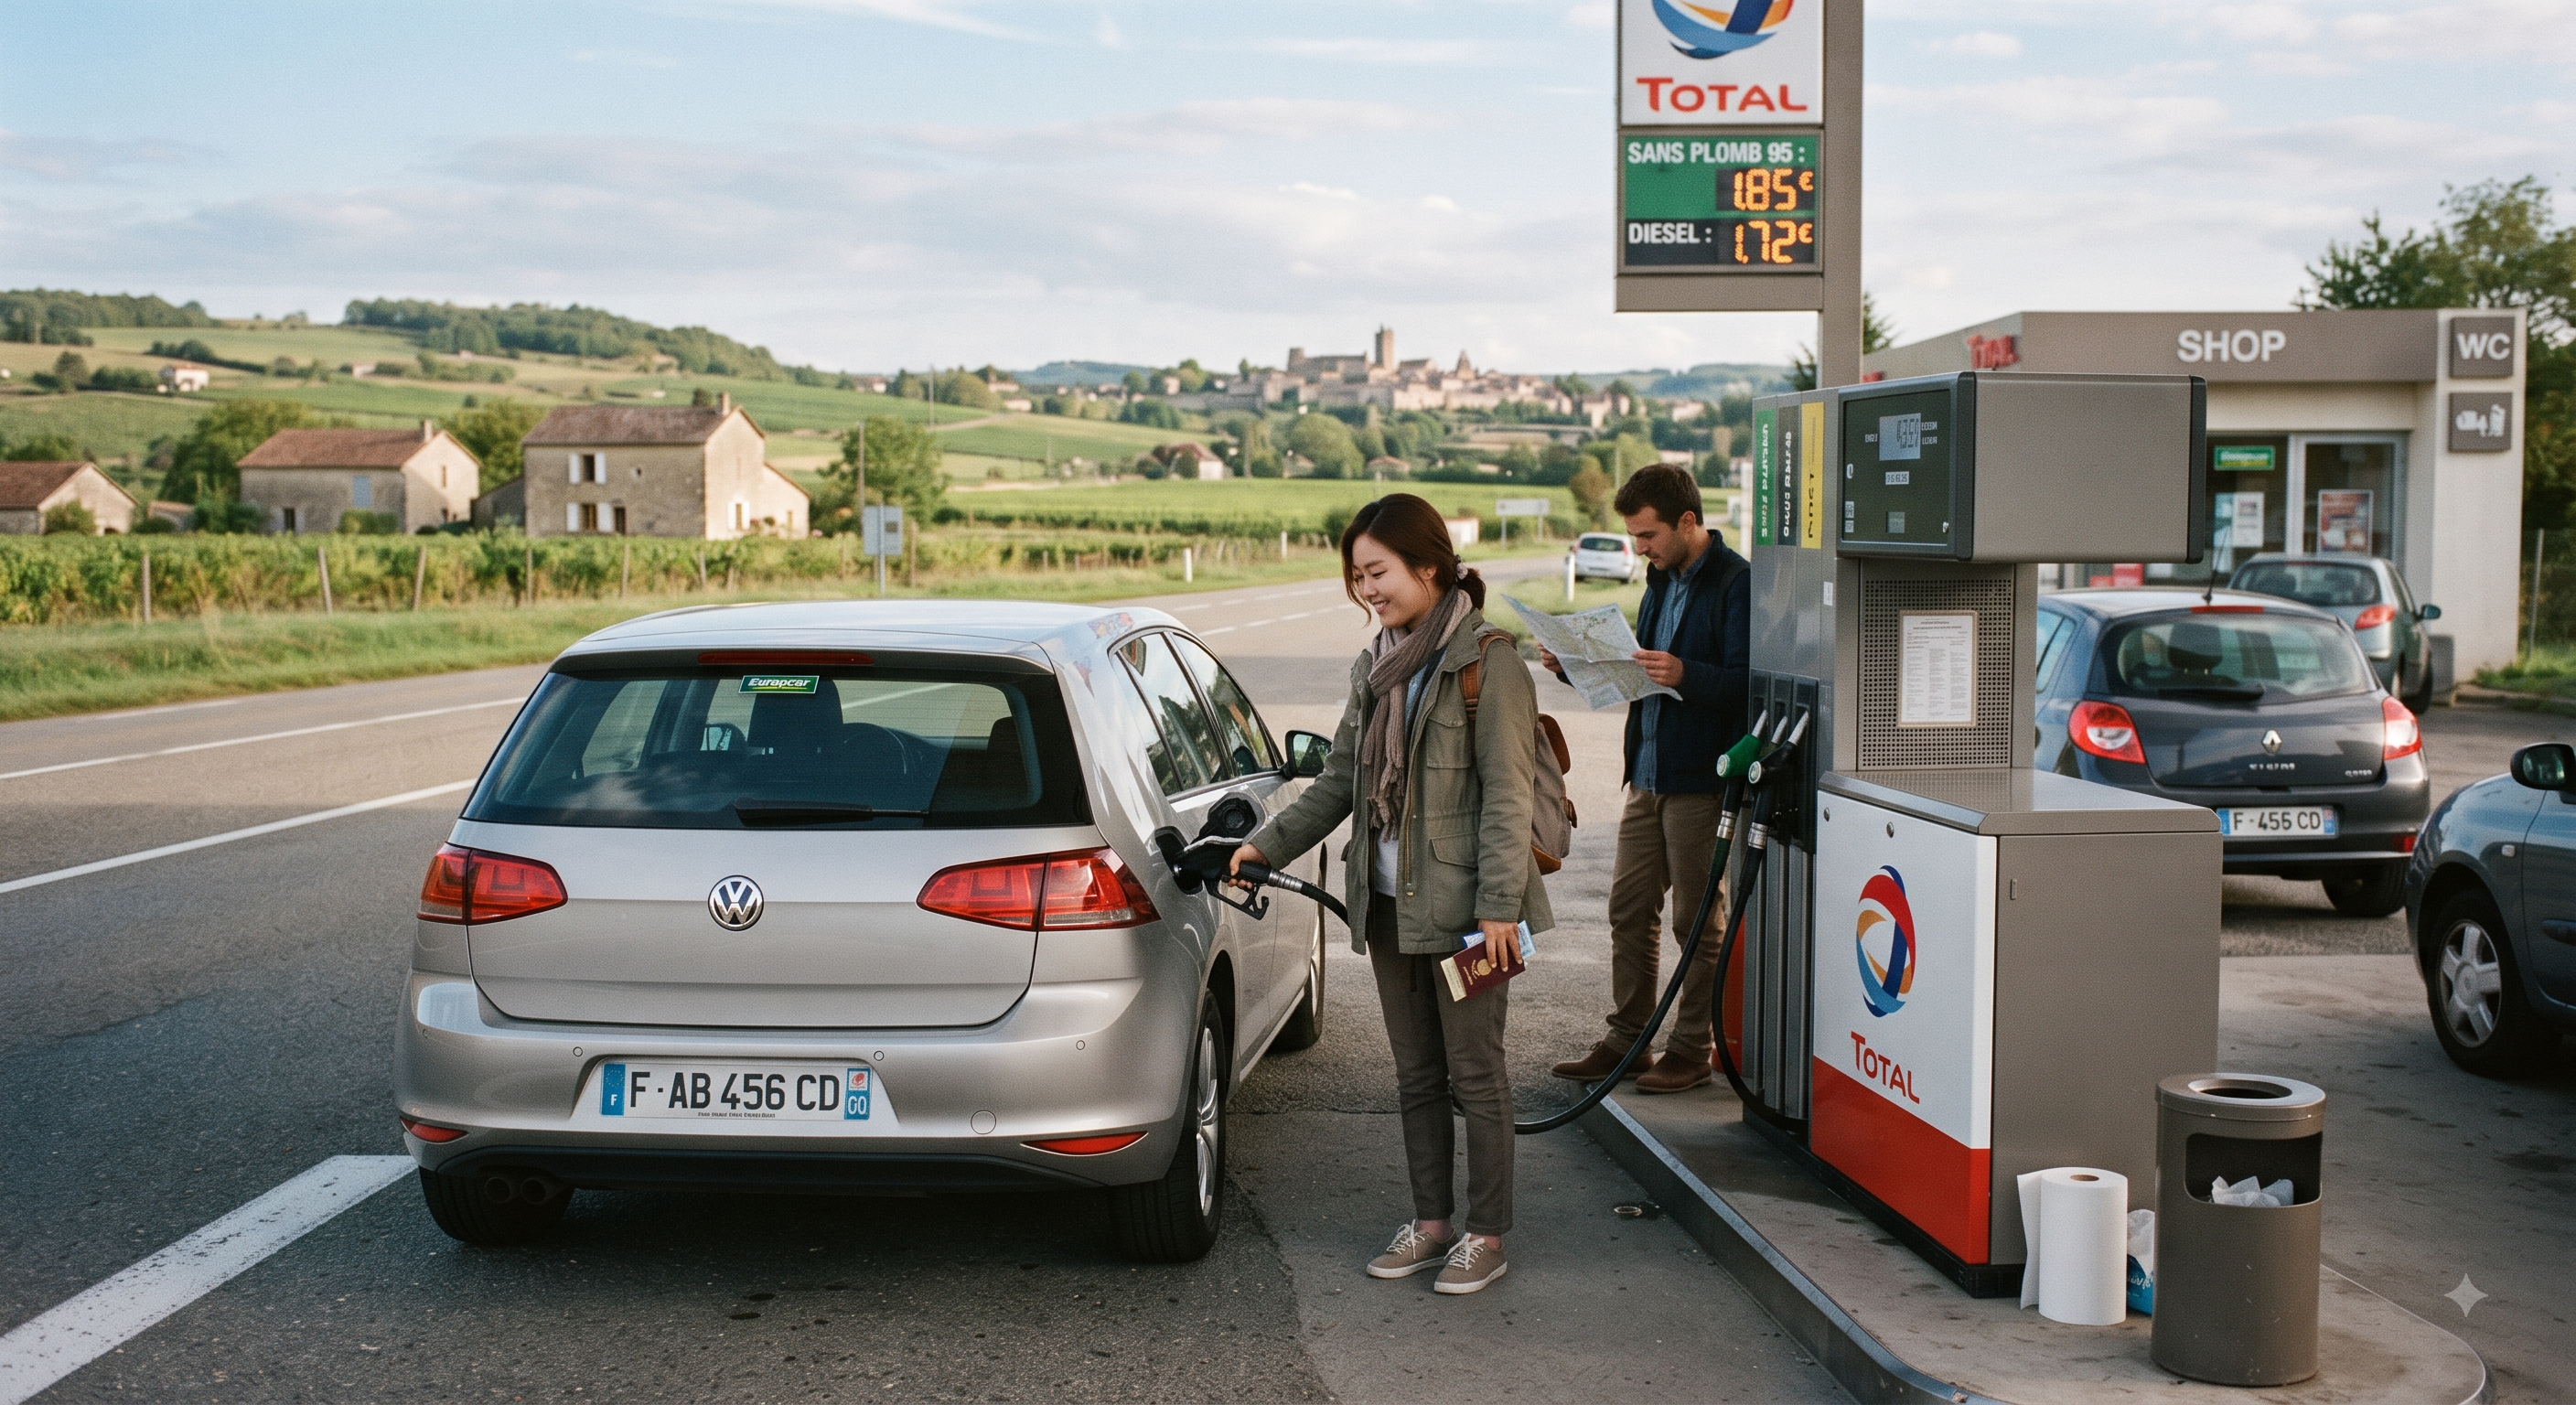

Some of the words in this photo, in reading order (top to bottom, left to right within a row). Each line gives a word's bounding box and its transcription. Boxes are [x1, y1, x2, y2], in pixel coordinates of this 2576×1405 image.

[1627, 142, 1684, 164] SANS
[1690, 142, 1763, 164] PLOMB
[1767, 142, 1793, 164] 95
[1628, 222, 1701, 244] DIESEL
[2177, 329, 2287, 363] SHOP
[2456, 332, 2511, 360] WC
[2297, 811, 2321, 830] CD
[1851, 1030, 1920, 1104] TOTAL
[610, 1094, 617, 1107] F
[720, 1073, 786, 1110] 456
[796, 1074, 840, 1111] CD
